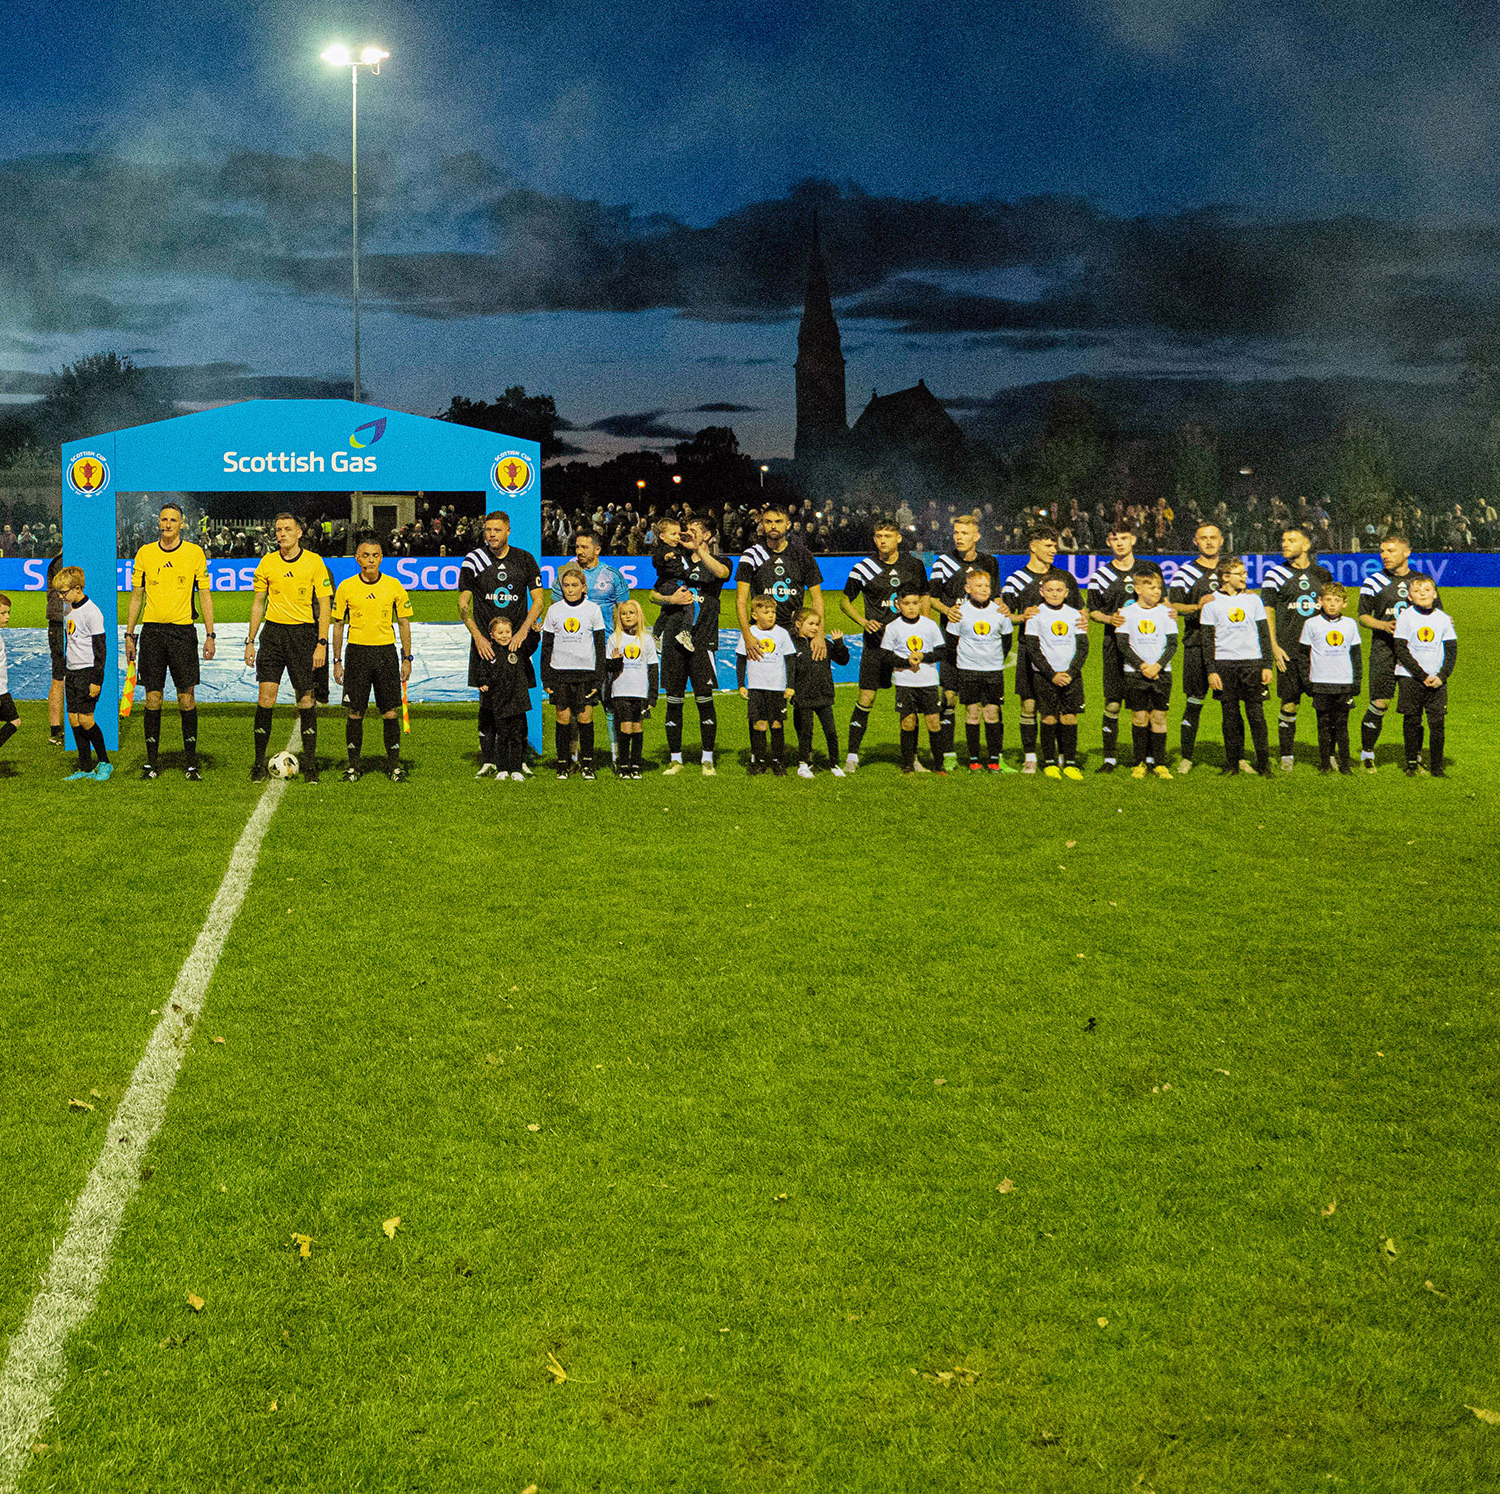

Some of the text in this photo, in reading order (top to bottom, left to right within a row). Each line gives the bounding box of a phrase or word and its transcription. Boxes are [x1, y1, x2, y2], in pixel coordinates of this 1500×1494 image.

[223, 451, 377, 473] Scottish Gas
[207, 559, 255, 591] as
